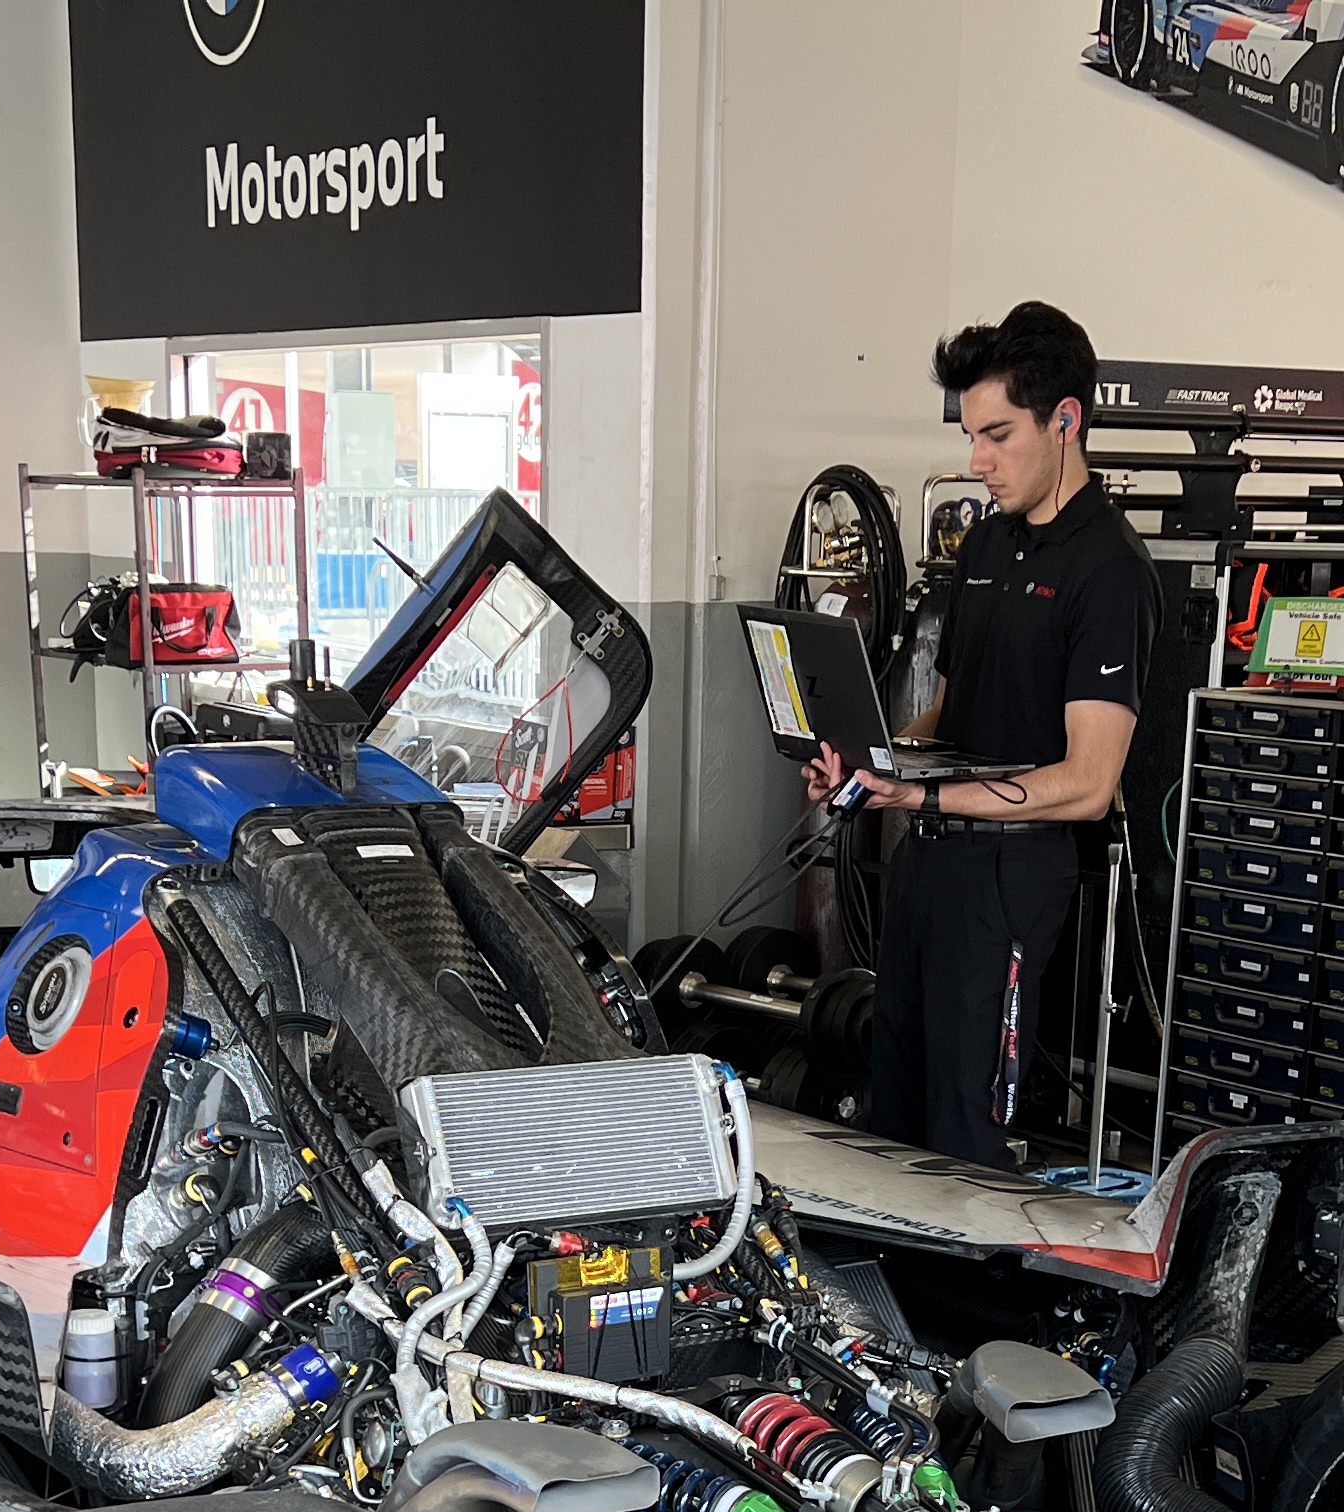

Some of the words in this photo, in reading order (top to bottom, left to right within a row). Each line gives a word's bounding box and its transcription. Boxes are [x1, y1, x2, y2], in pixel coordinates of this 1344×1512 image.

[1173, 27, 1191, 66] 24
[1230, 41, 1272, 80] iQOO
[205, 116, 445, 231] Motorsport
[1177, 389, 1201, 401] FAST
[1200, 390, 1230, 402] TRACK
